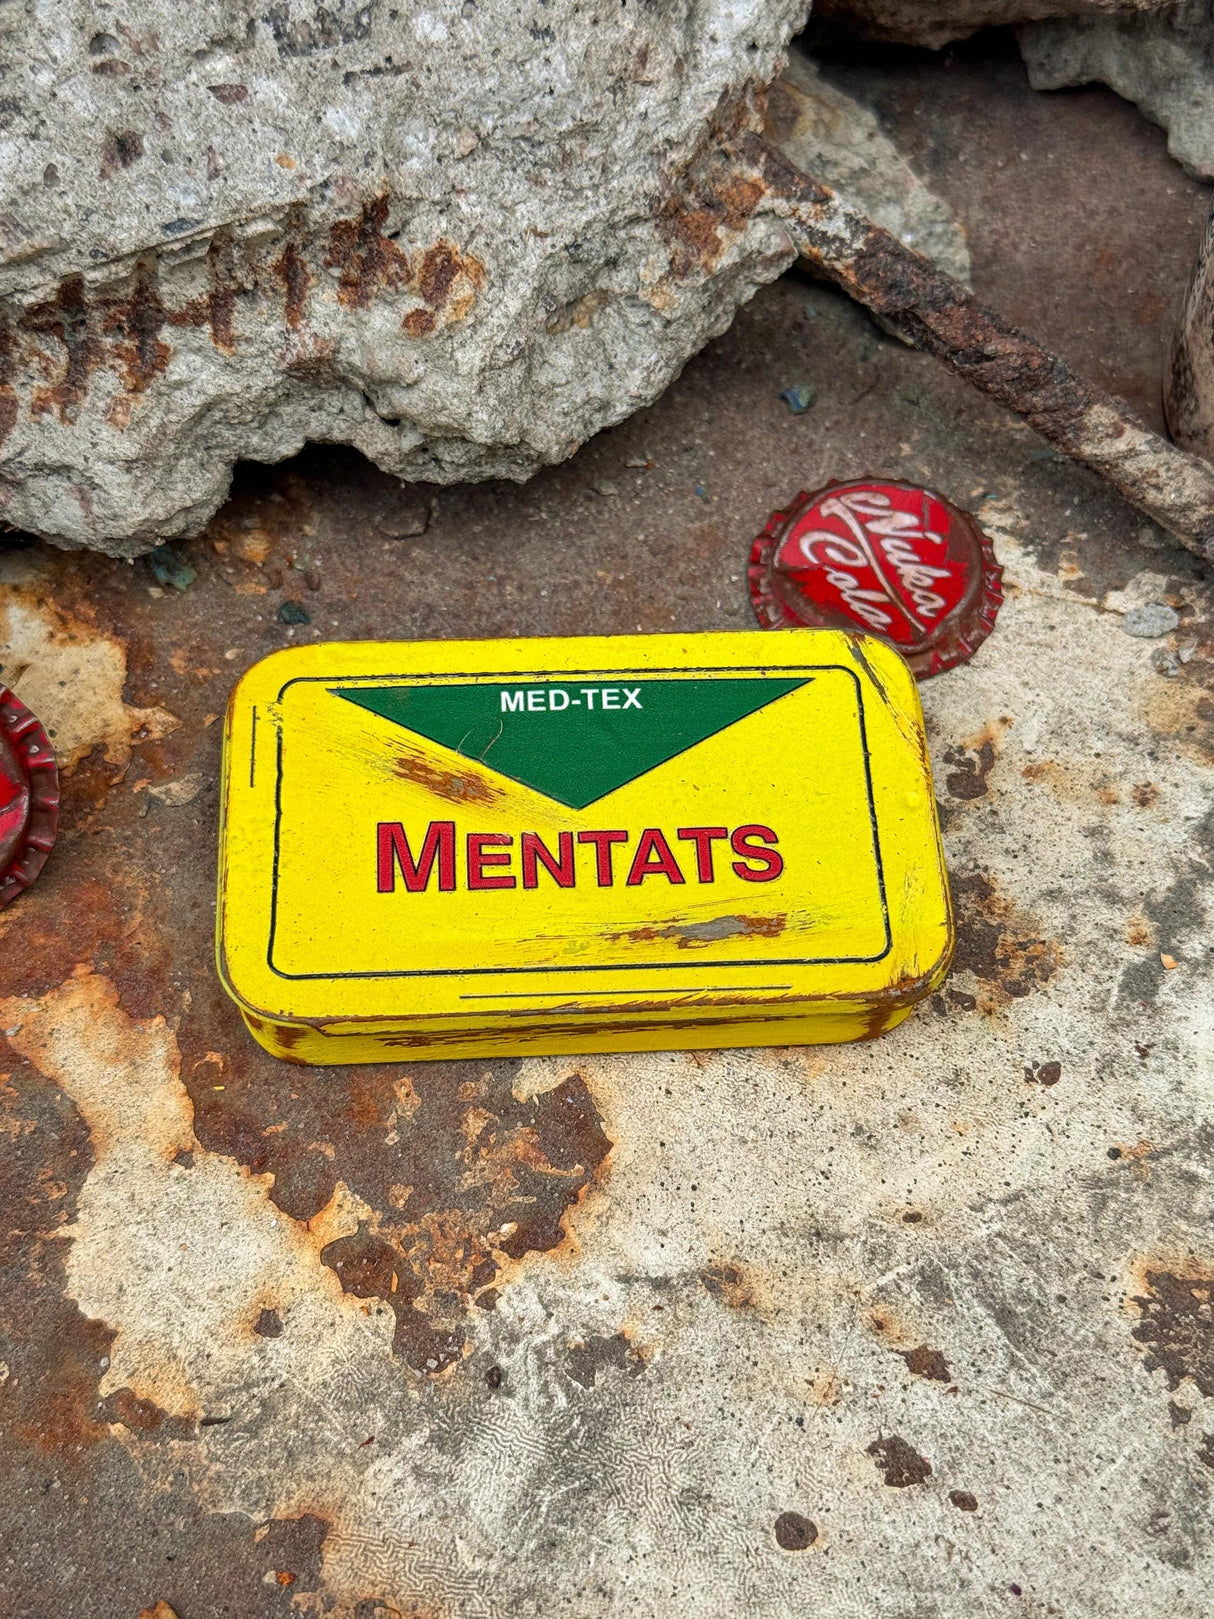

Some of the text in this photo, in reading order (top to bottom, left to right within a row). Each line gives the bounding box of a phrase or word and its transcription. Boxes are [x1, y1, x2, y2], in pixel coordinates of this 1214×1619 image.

[799, 529, 893, 632] Cola
[837, 490, 952, 618] Nuka
[500, 687, 644, 713] MED-TEX
[376, 820, 785, 893] MENTATS
